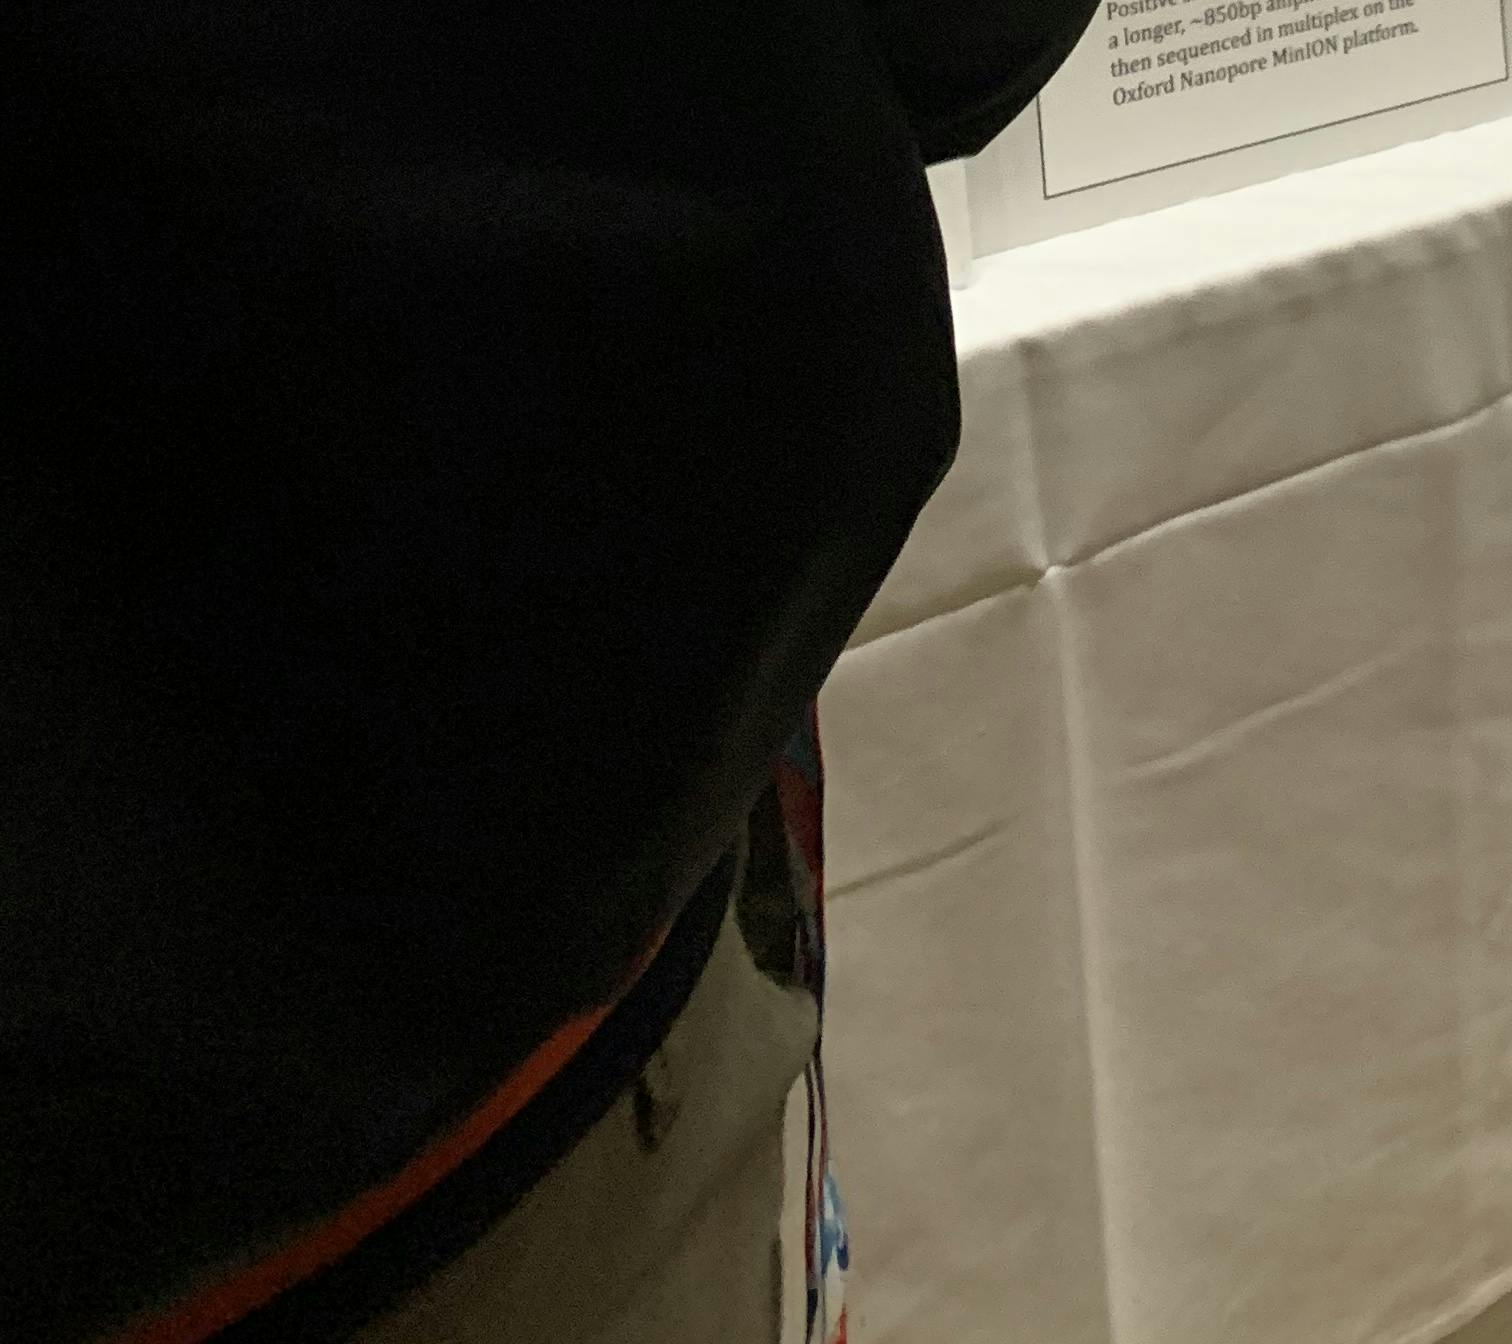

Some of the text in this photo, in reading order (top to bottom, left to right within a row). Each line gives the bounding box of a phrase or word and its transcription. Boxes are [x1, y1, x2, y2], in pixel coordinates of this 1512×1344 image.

[1108, 35, 1119, 50] a
[1123, 19, 1186, 46] longer,
[1112, 74, 1175, 106] Oxford
[1180, 57, 1268, 91] Nanopore
[1272, 35, 1338, 67] MinION
